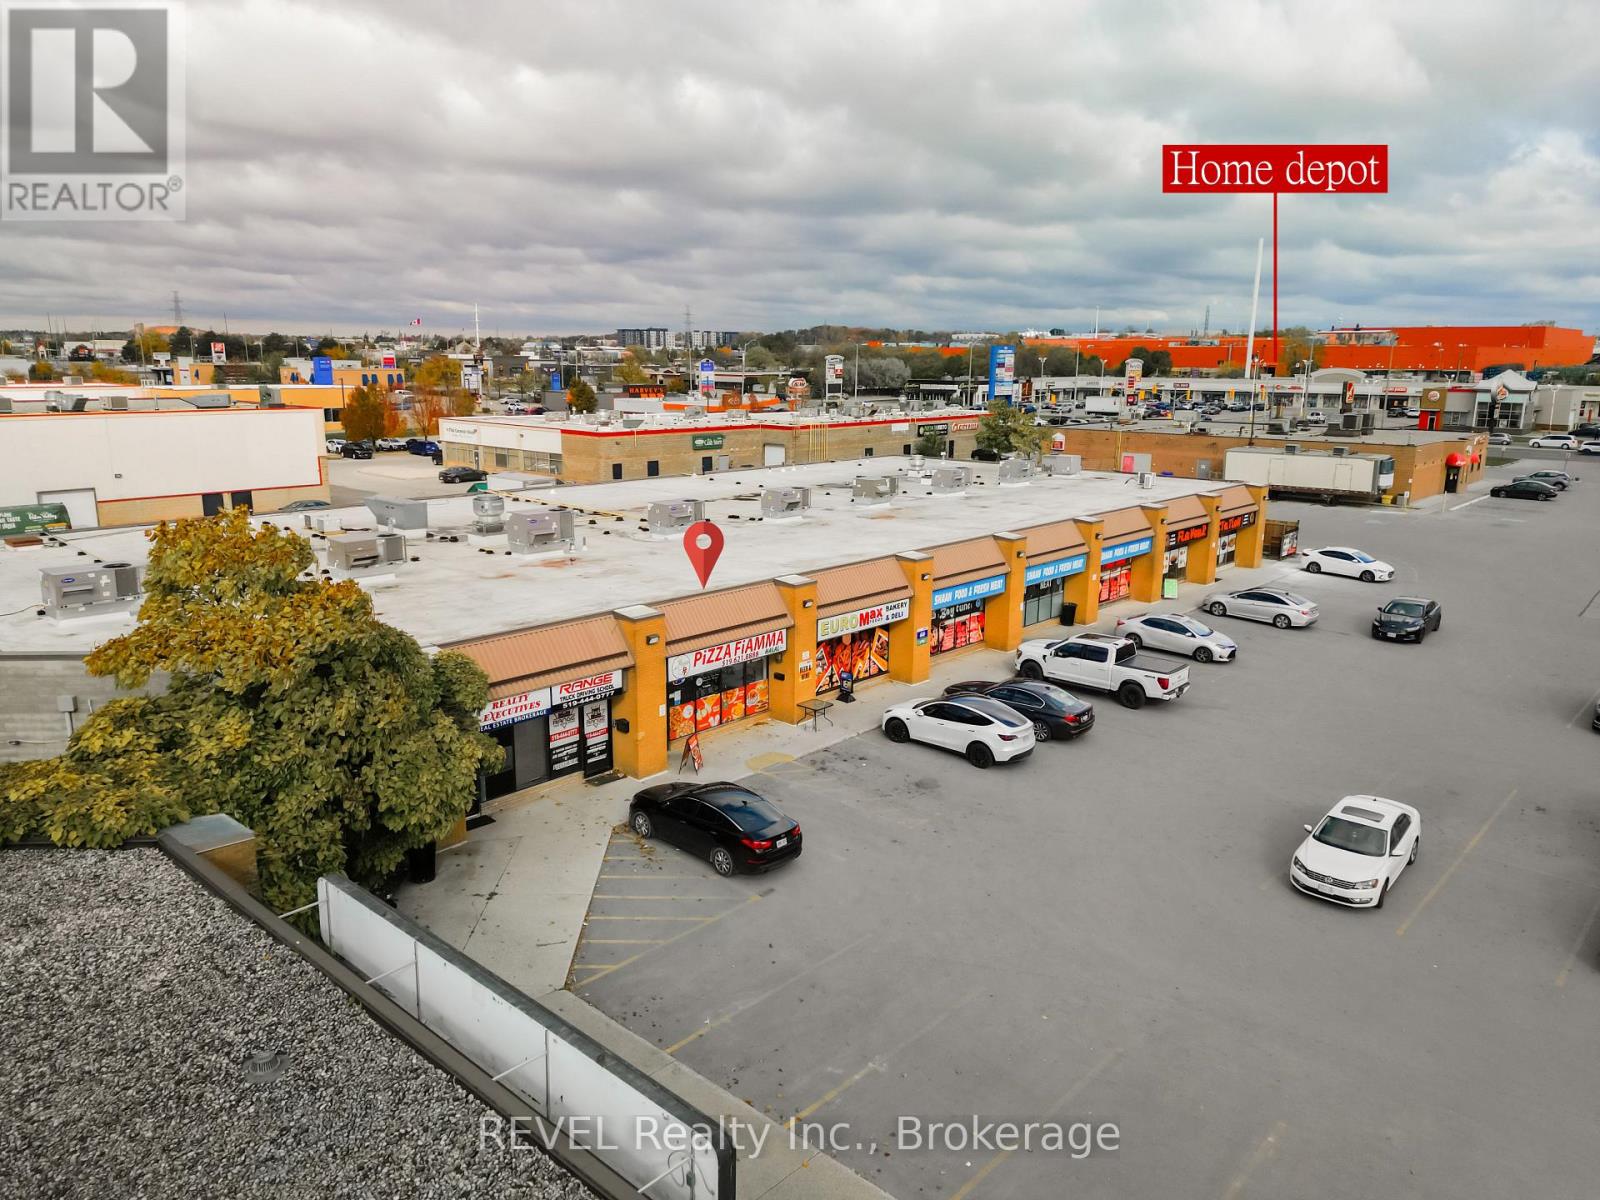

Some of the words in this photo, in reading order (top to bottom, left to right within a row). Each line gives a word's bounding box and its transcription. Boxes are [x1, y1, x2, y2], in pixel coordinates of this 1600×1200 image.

[954, 588, 968, 600] FOOD
[973, 582, 990, 596] FRESH
[886, 601, 908, 612] BAKERY
[891, 611, 904, 620] DELI
[559, 673, 614, 695] RANGE
[560, 693, 576, 702] TRUCK
[576, 689, 596, 699] DRIVING
[596, 684, 615, 694] SCHOOL
[492, 693, 530, 710] REALTY
[562, 690, 615, 709] 519-444-0777
[480, 723, 492, 732] EAL
[493, 718, 513, 729] ESTATE
[514, 709, 547, 723] BROKERAGE
[482, 700, 542, 723] EXECUTIVES
